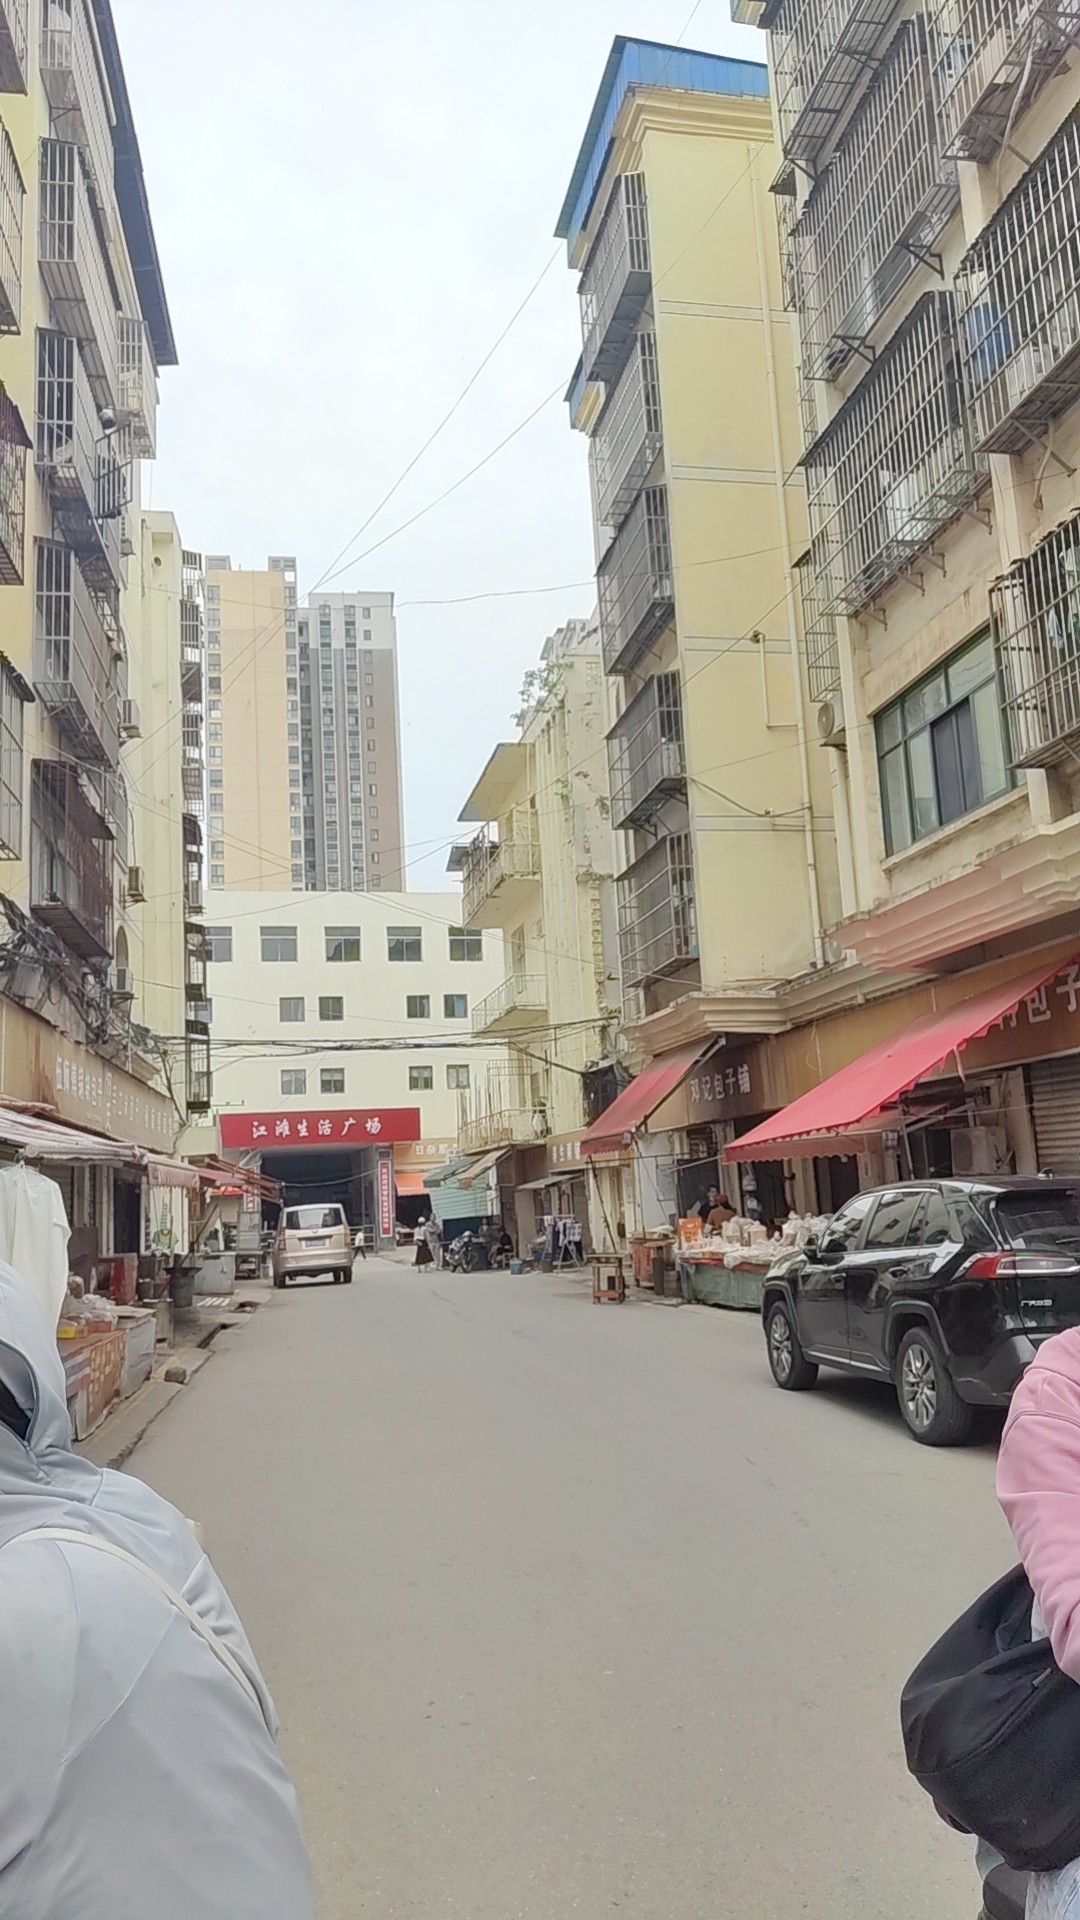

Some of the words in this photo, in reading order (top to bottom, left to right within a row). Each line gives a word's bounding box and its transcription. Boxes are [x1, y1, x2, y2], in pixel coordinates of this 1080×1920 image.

[1000, 964, 1080, 1030] 包子
[690, 1064, 751, 1103] 邓记包子铺
[252, 1117, 382, 1139] 江滩生活广场
